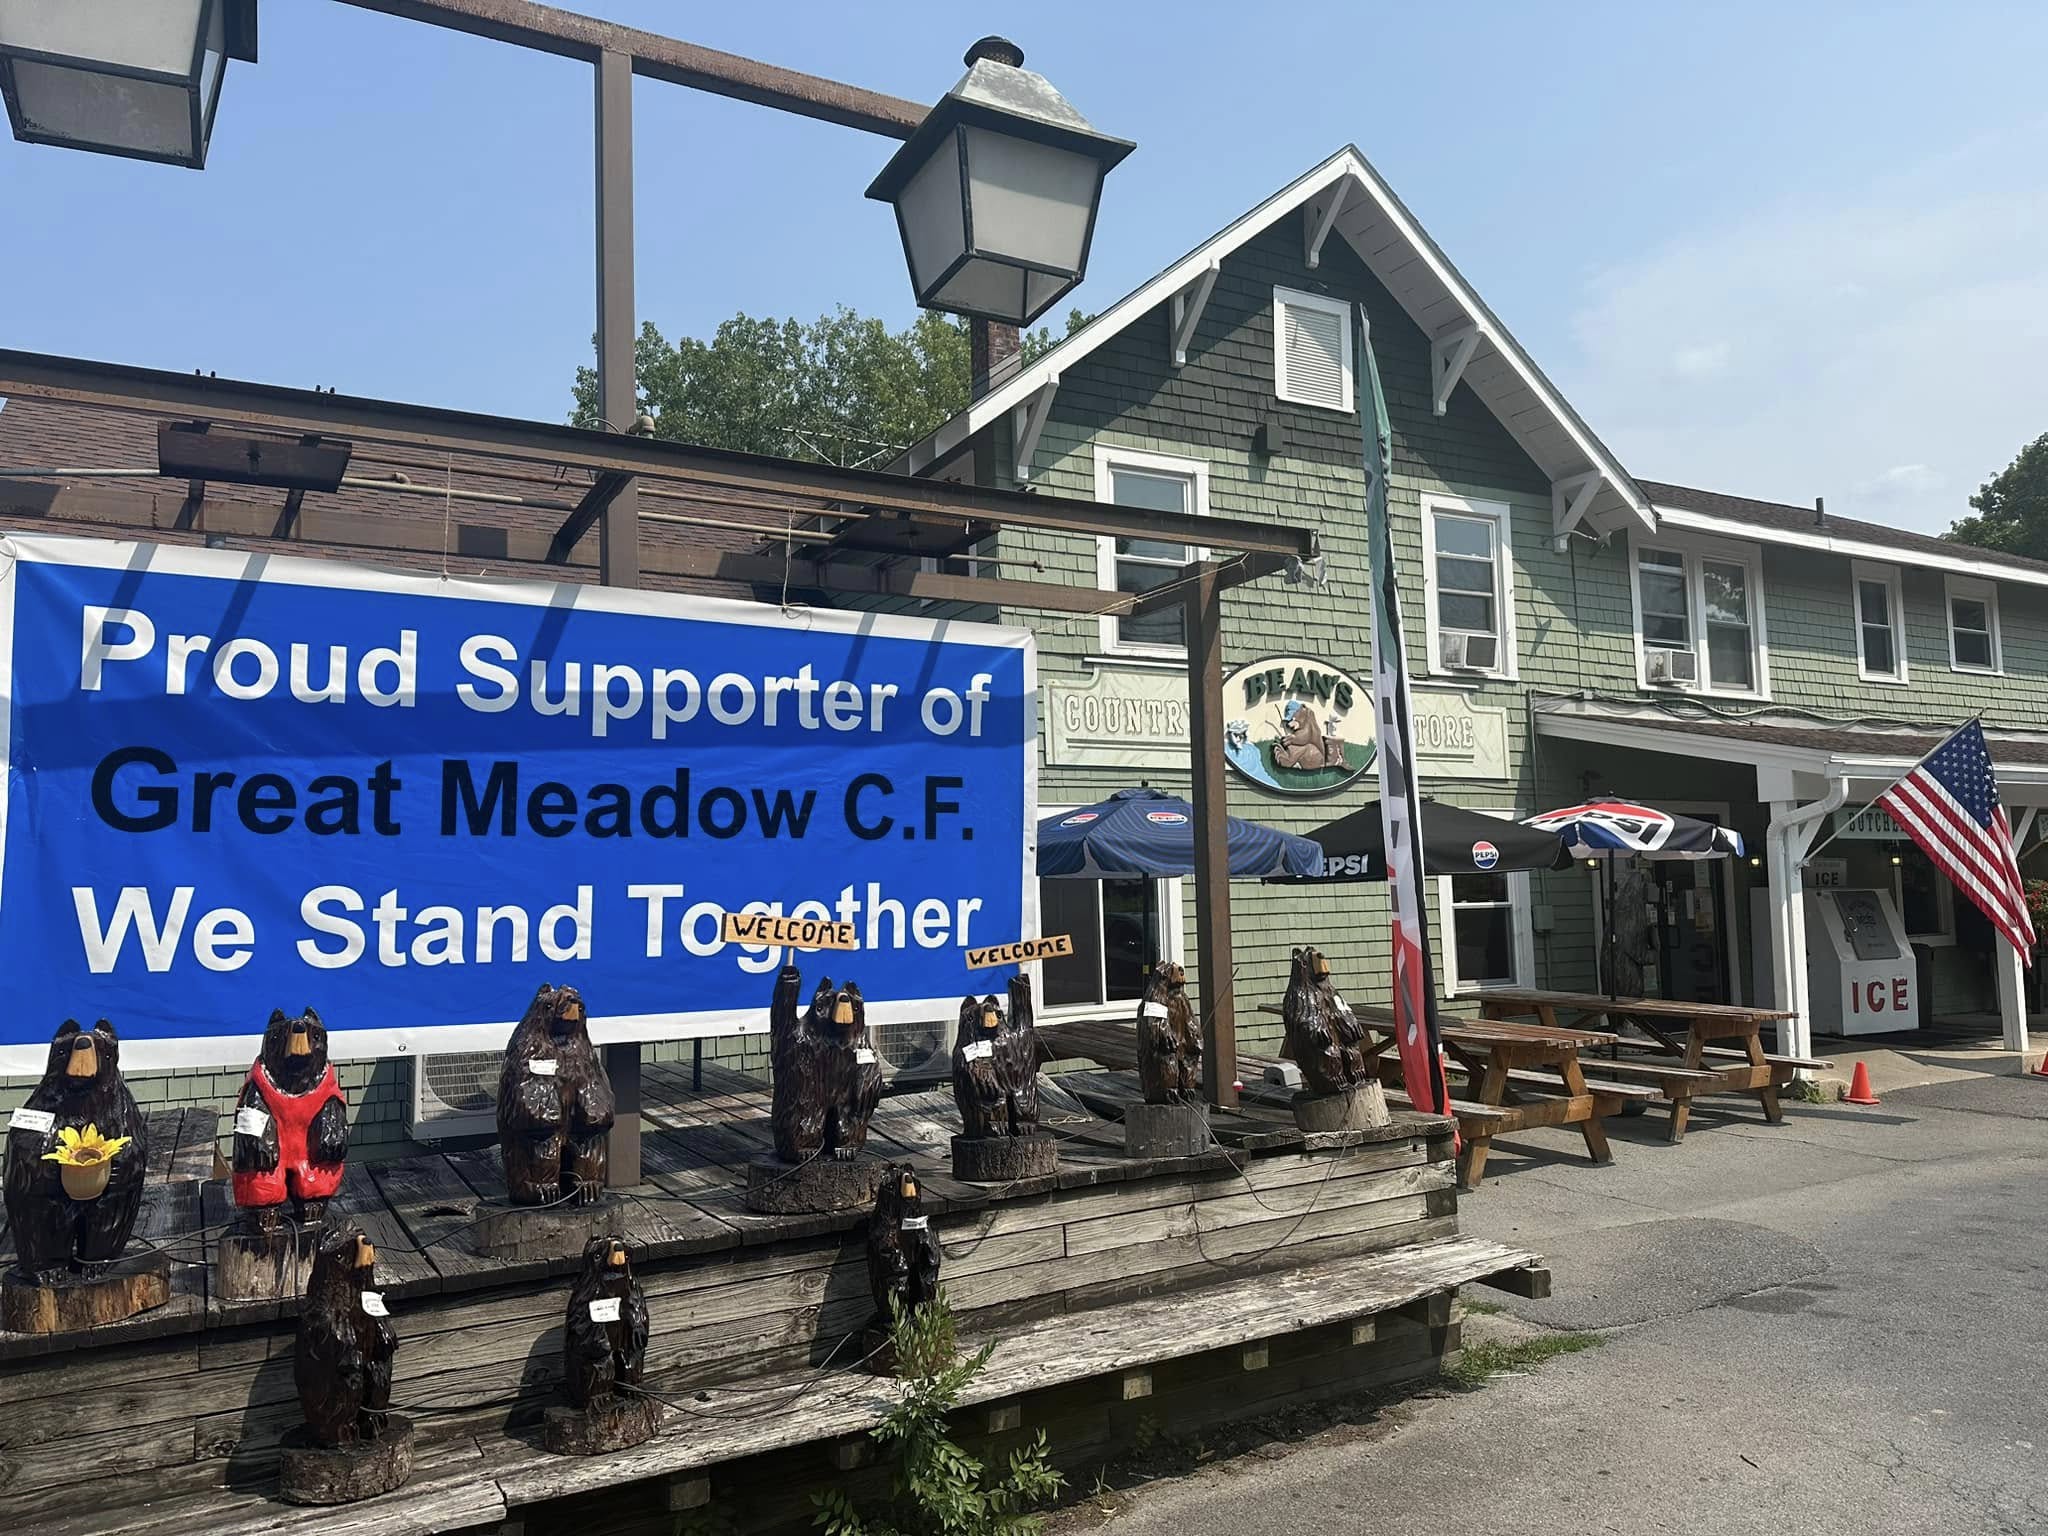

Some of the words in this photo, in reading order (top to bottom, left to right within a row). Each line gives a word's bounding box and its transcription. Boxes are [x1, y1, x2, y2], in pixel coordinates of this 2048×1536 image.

[80, 605, 417, 708] Proud
[456, 634, 898, 740] Supporter
[920, 673, 992, 737] of
[1244, 667, 1354, 712] BEAN'S
[1412, 714, 1475, 749] TORE
[91, 746, 402, 837] Great
[441, 760, 817, 841] Meadow
[843, 773, 974, 841] C.F.
[1848, 812, 1905, 832] BUTCHE
[1815, 872, 1839, 886] ICE
[71, 886, 256, 974] We
[296, 884, 593, 970] Stand
[733, 916, 852, 945] WELCOME
[968, 938, 1067, 966] WELCOME
[1852, 977, 1909, 1014] ICE
